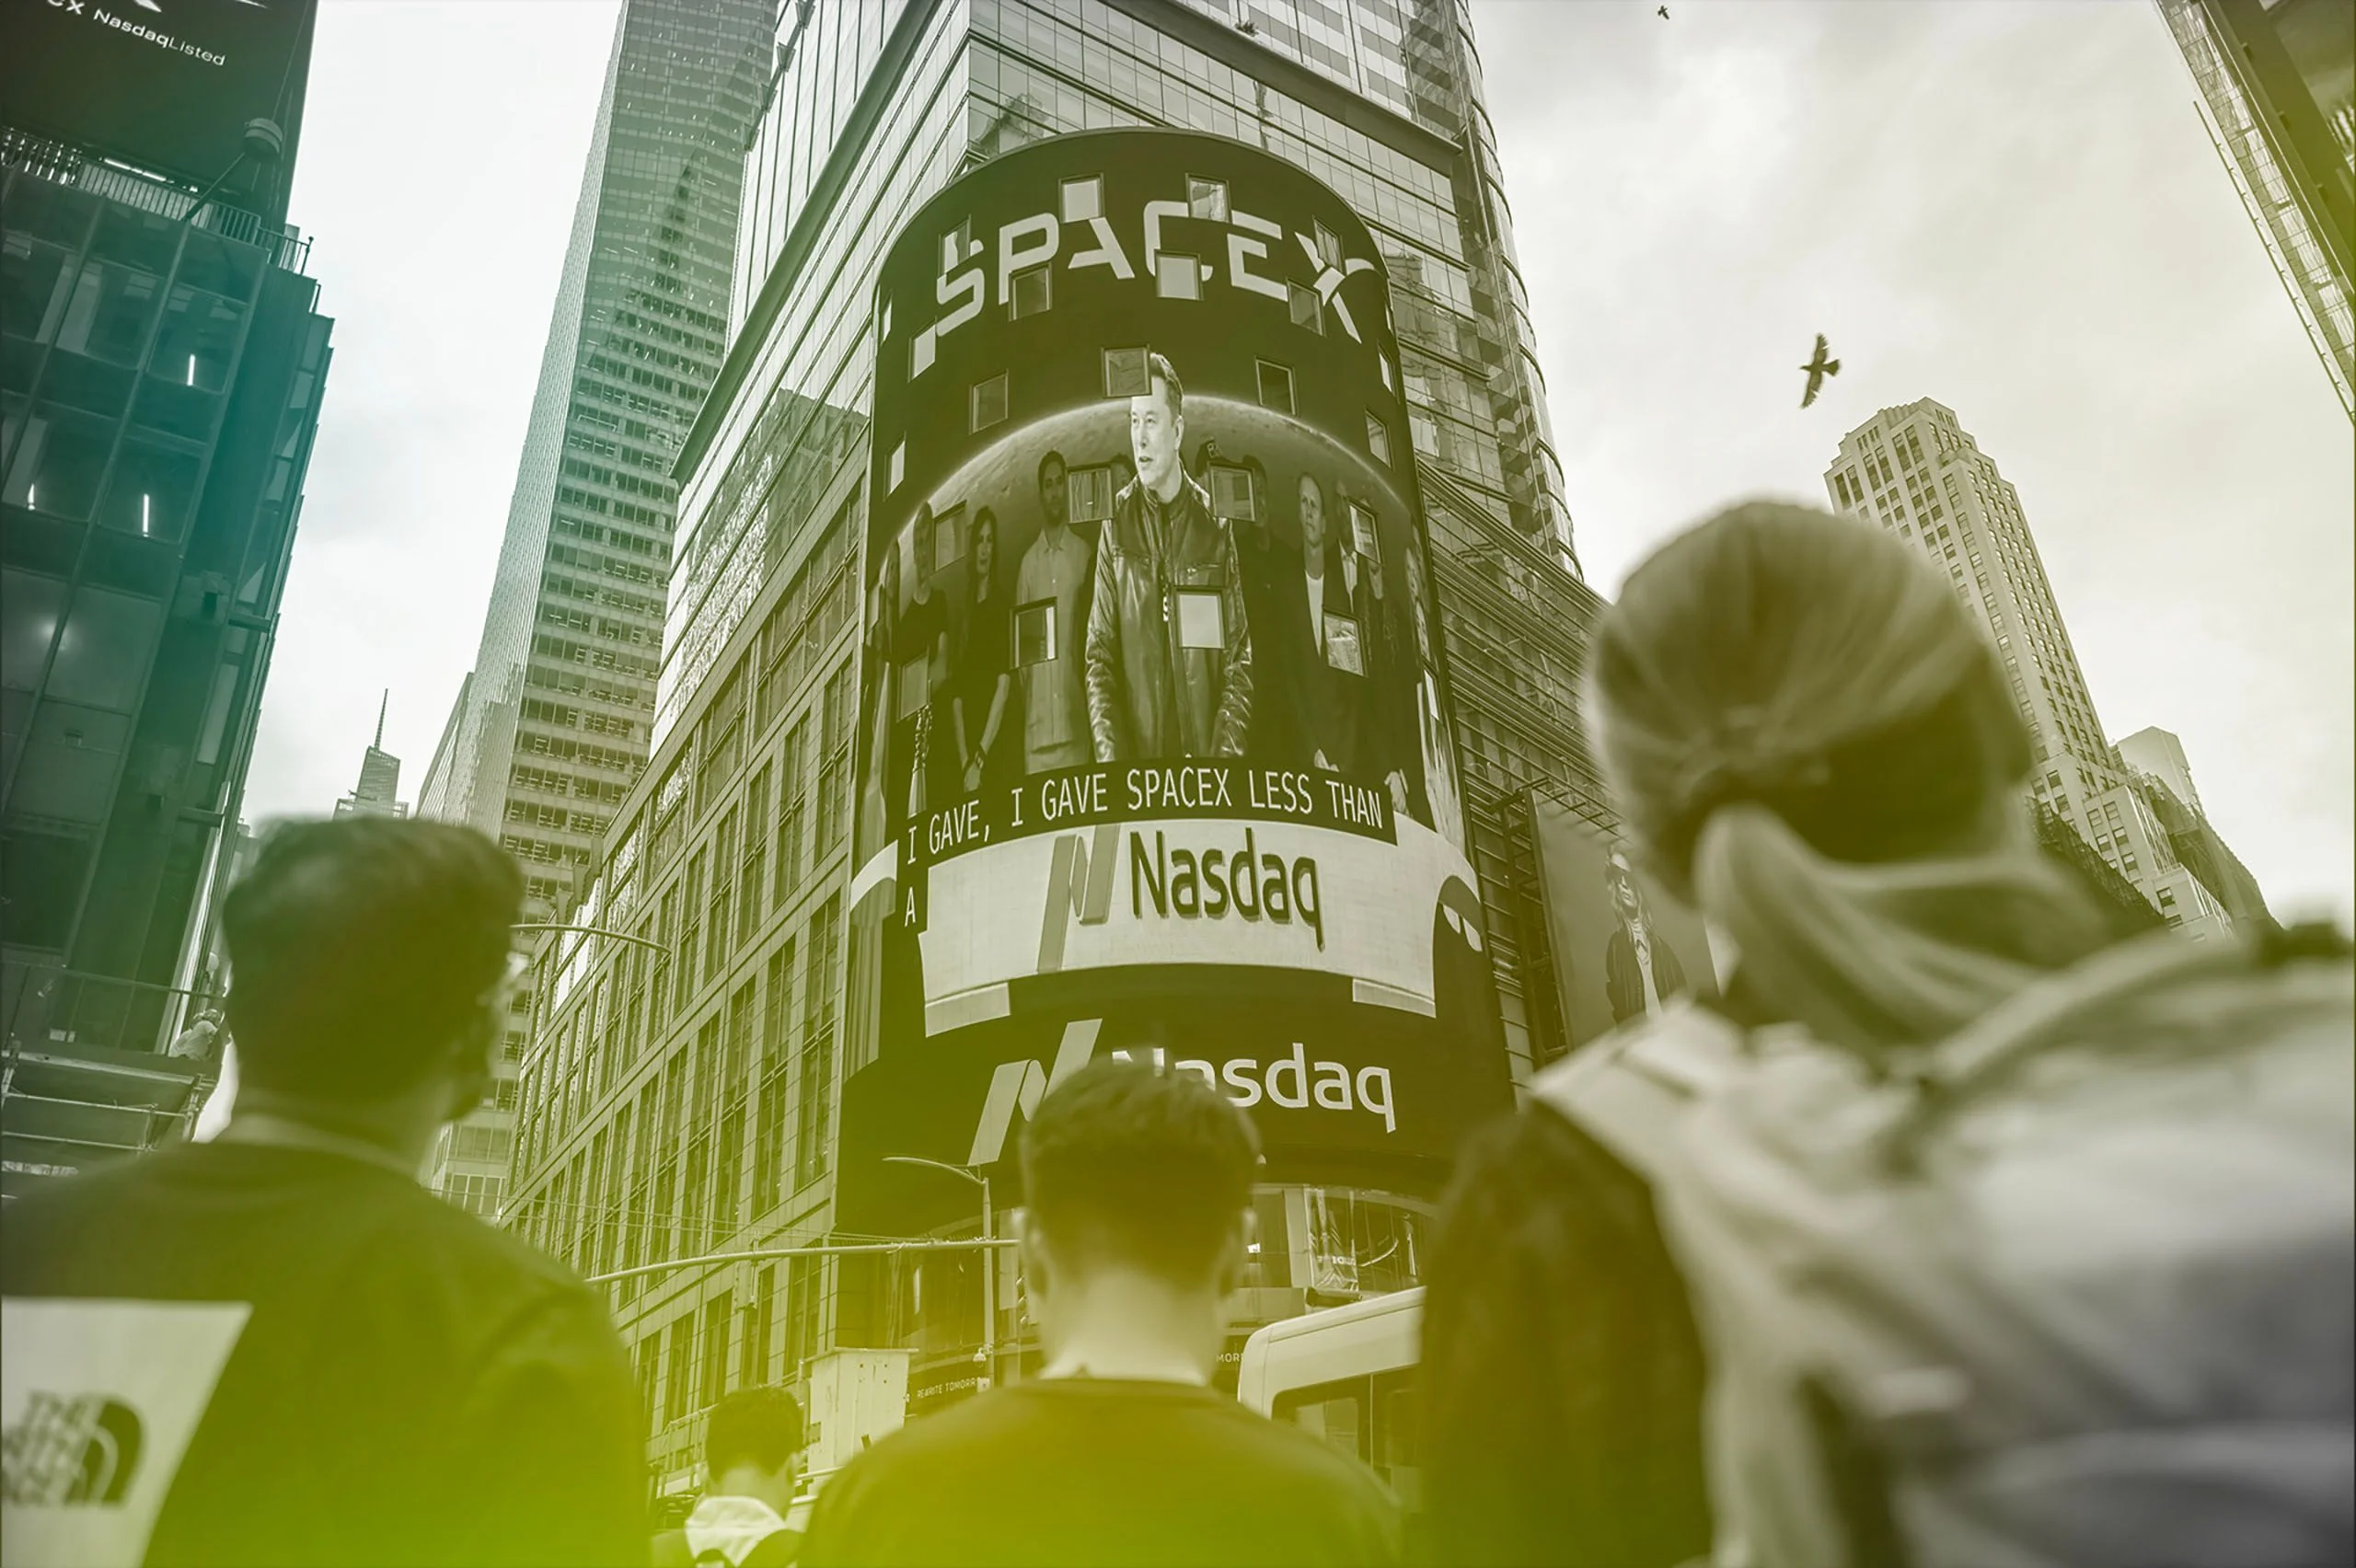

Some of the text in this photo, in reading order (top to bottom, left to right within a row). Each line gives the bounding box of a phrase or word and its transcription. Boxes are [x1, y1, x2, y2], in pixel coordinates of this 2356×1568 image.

[936, 201, 1376, 344] SPACEX
[907, 766, 1383, 865] I GAVE, I GAVE SPACEX LESS THAN
[905, 885, 917, 928] A
[1129, 827, 1325, 953] Nasdaq
[1112, 1043, 1396, 1134] sdaq
[945, 1376, 981, 1392] TOMORR
[1216, 1352, 1243, 1363] MOR
